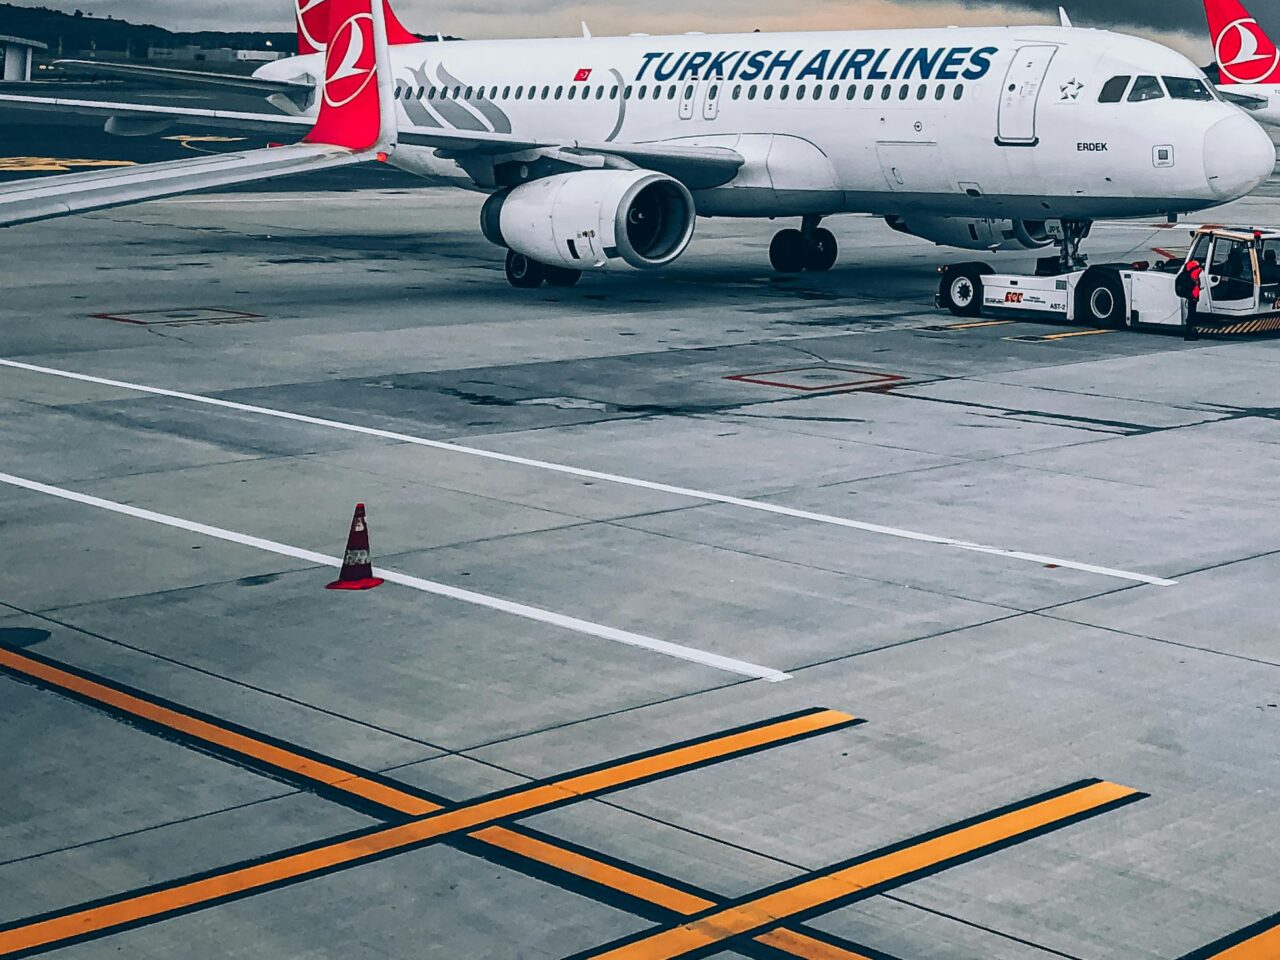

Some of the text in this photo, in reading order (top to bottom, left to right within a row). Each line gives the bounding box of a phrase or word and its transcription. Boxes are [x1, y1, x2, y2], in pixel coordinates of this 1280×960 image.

[635, 47, 999, 81] TURKISH AIRLINES
[1077, 142, 1108, 151] ERDEK
